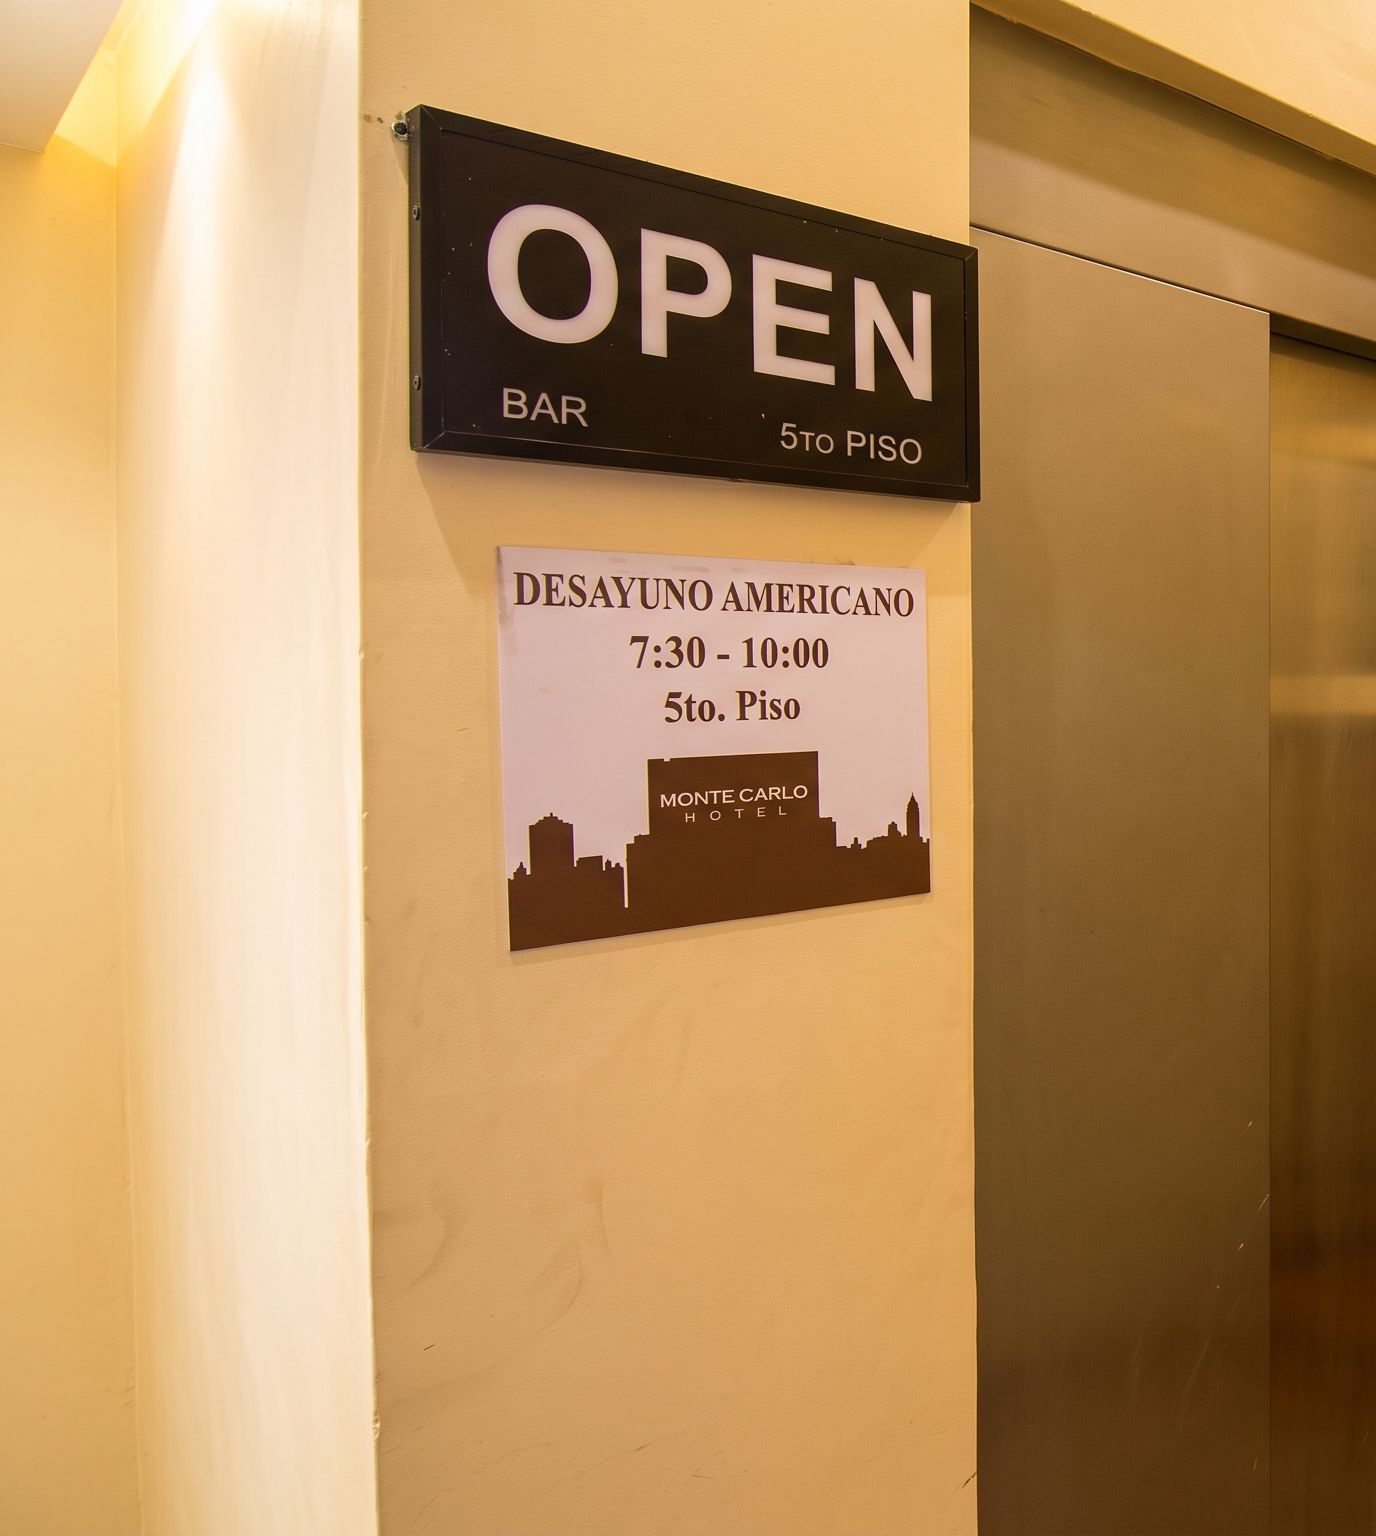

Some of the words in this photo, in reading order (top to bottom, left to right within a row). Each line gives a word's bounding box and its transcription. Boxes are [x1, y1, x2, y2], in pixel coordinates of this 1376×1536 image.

[487, 203, 932, 402] OPEN
[502, 387, 589, 428] BAR
[846, 430, 922, 465] PISO
[513, 572, 713, 611] DESAYUNO
[721, 581, 915, 617] AMERICANO
[629, 635, 706, 669] 7:30
[716, 652, 730, 661] -
[741, 637, 829, 668] 10:00
[664, 691, 725, 724] 5to.
[735, 690, 801, 722] Piso
[660, 789, 735, 808] MONTE
[739, 785, 808, 803] CARLO
[685, 806, 787, 823] HOTEL
